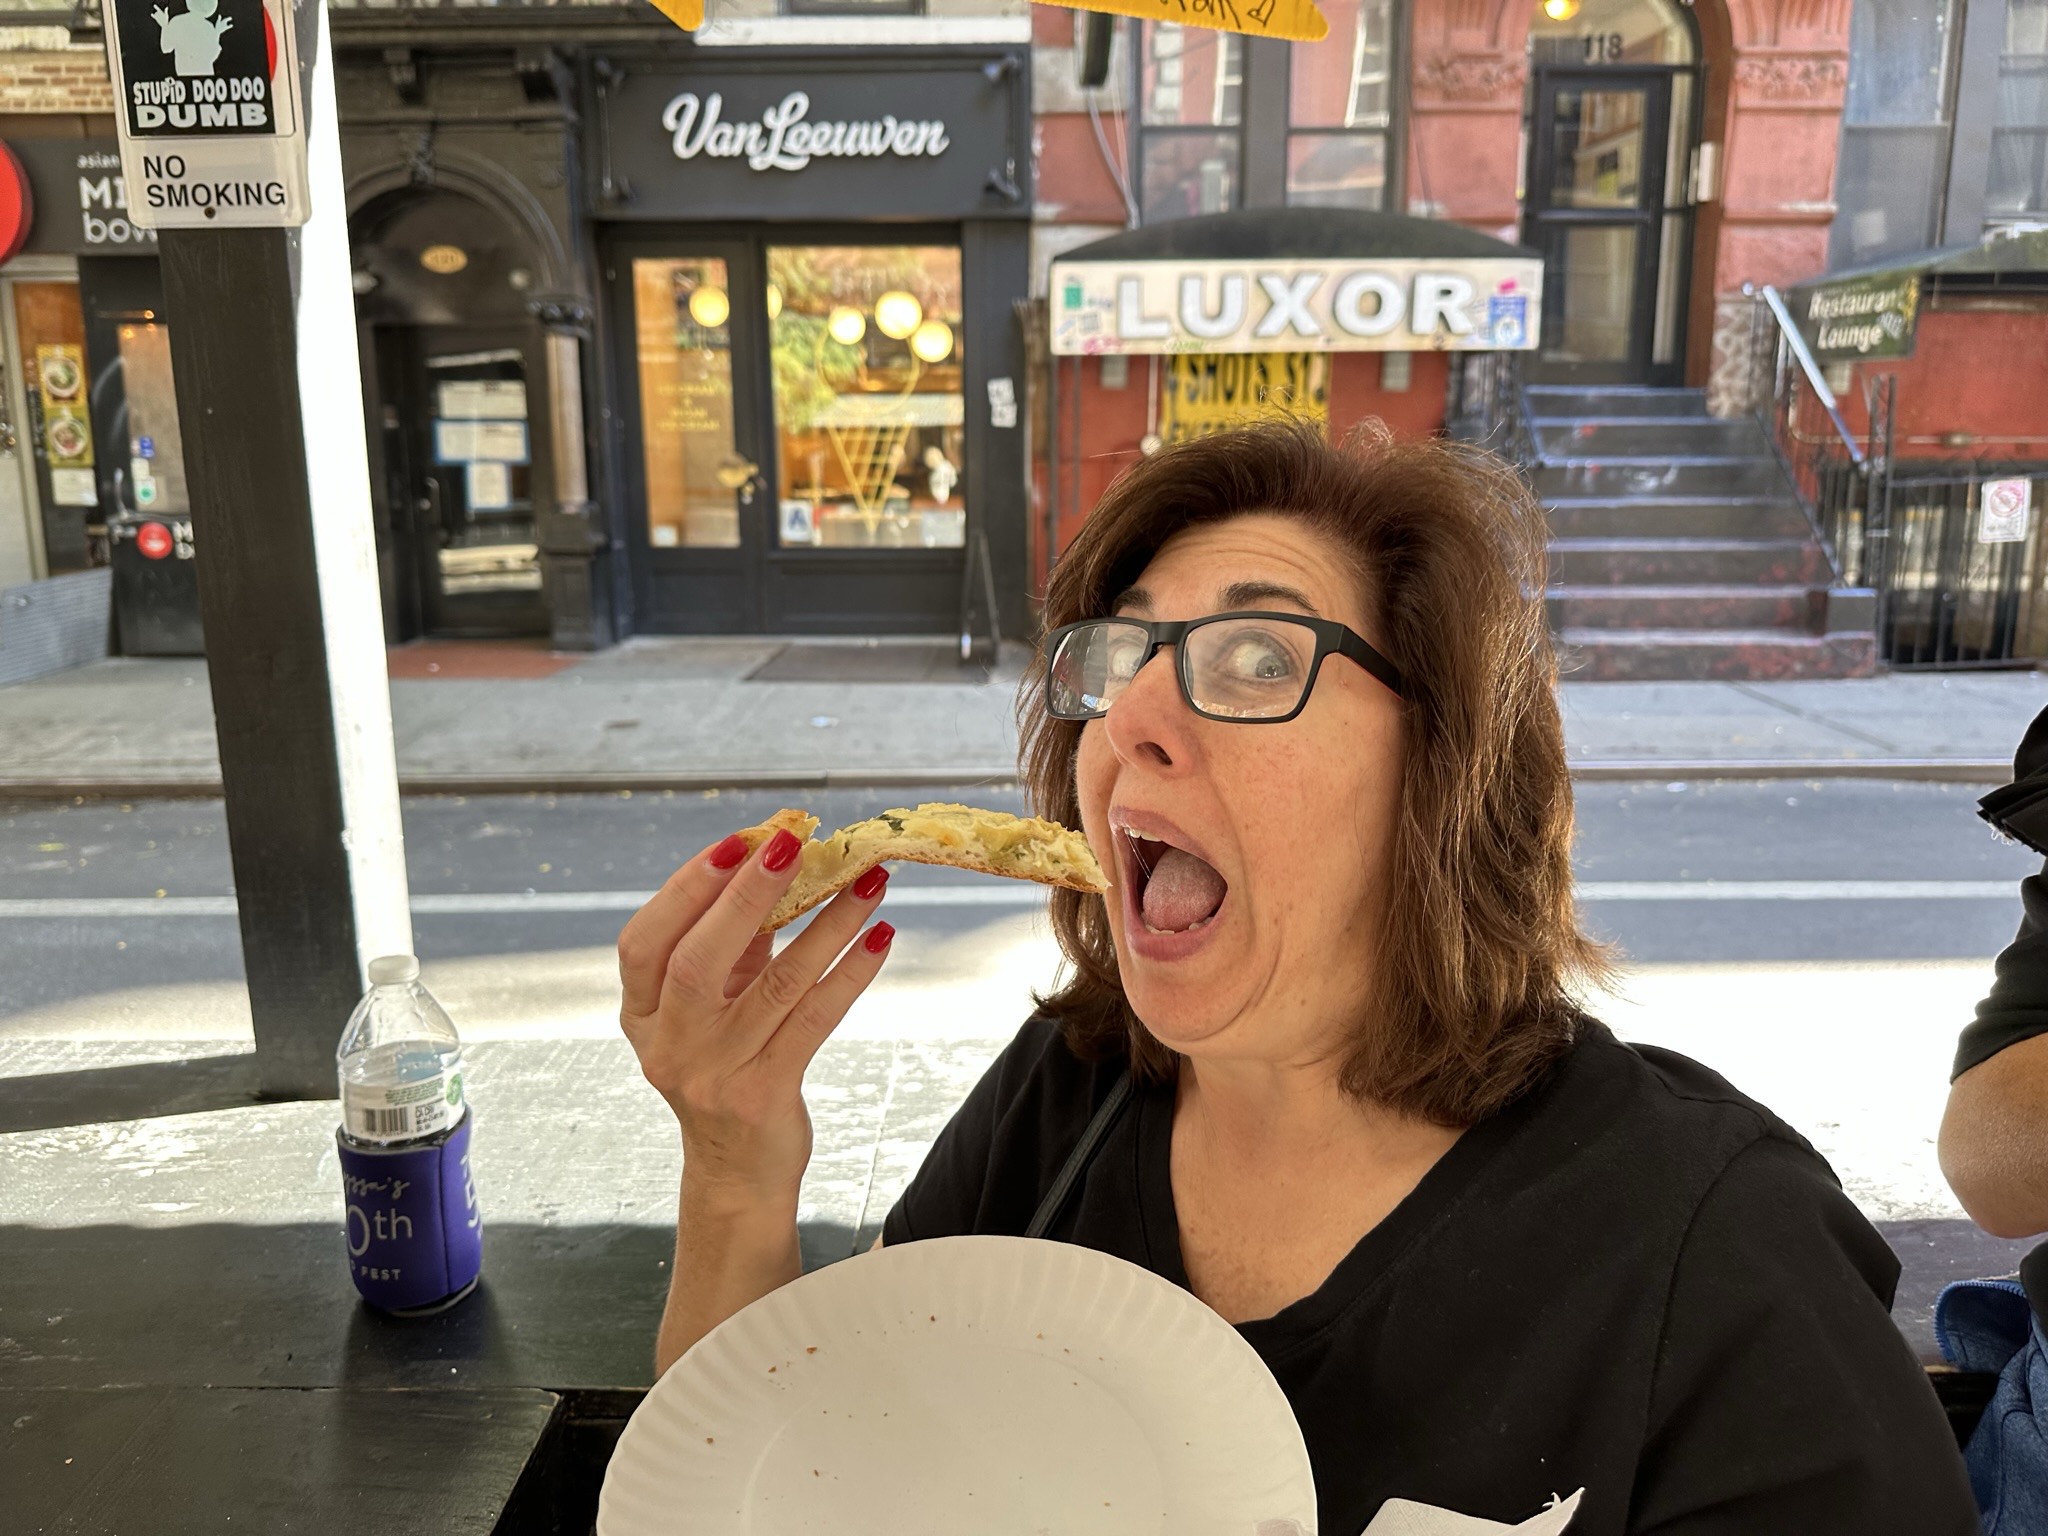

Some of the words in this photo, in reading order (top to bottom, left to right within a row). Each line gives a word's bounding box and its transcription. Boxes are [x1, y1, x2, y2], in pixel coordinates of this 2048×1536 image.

[1584, 32, 1624, 62] 118
[192, 78, 227, 102] DOO
[230, 76, 265, 101] DOO
[136, 103, 268, 128] DUMB
[143, 155, 186, 179] NO
[79, 176, 127, 209] MI
[147, 182, 286, 208] SMOKING
[83, 211, 158, 243] bow
[1116, 271, 1476, 338] LUXOR
[1817, 322, 1884, 353] Lounge
[361, 1265, 401, 1280] FEST
